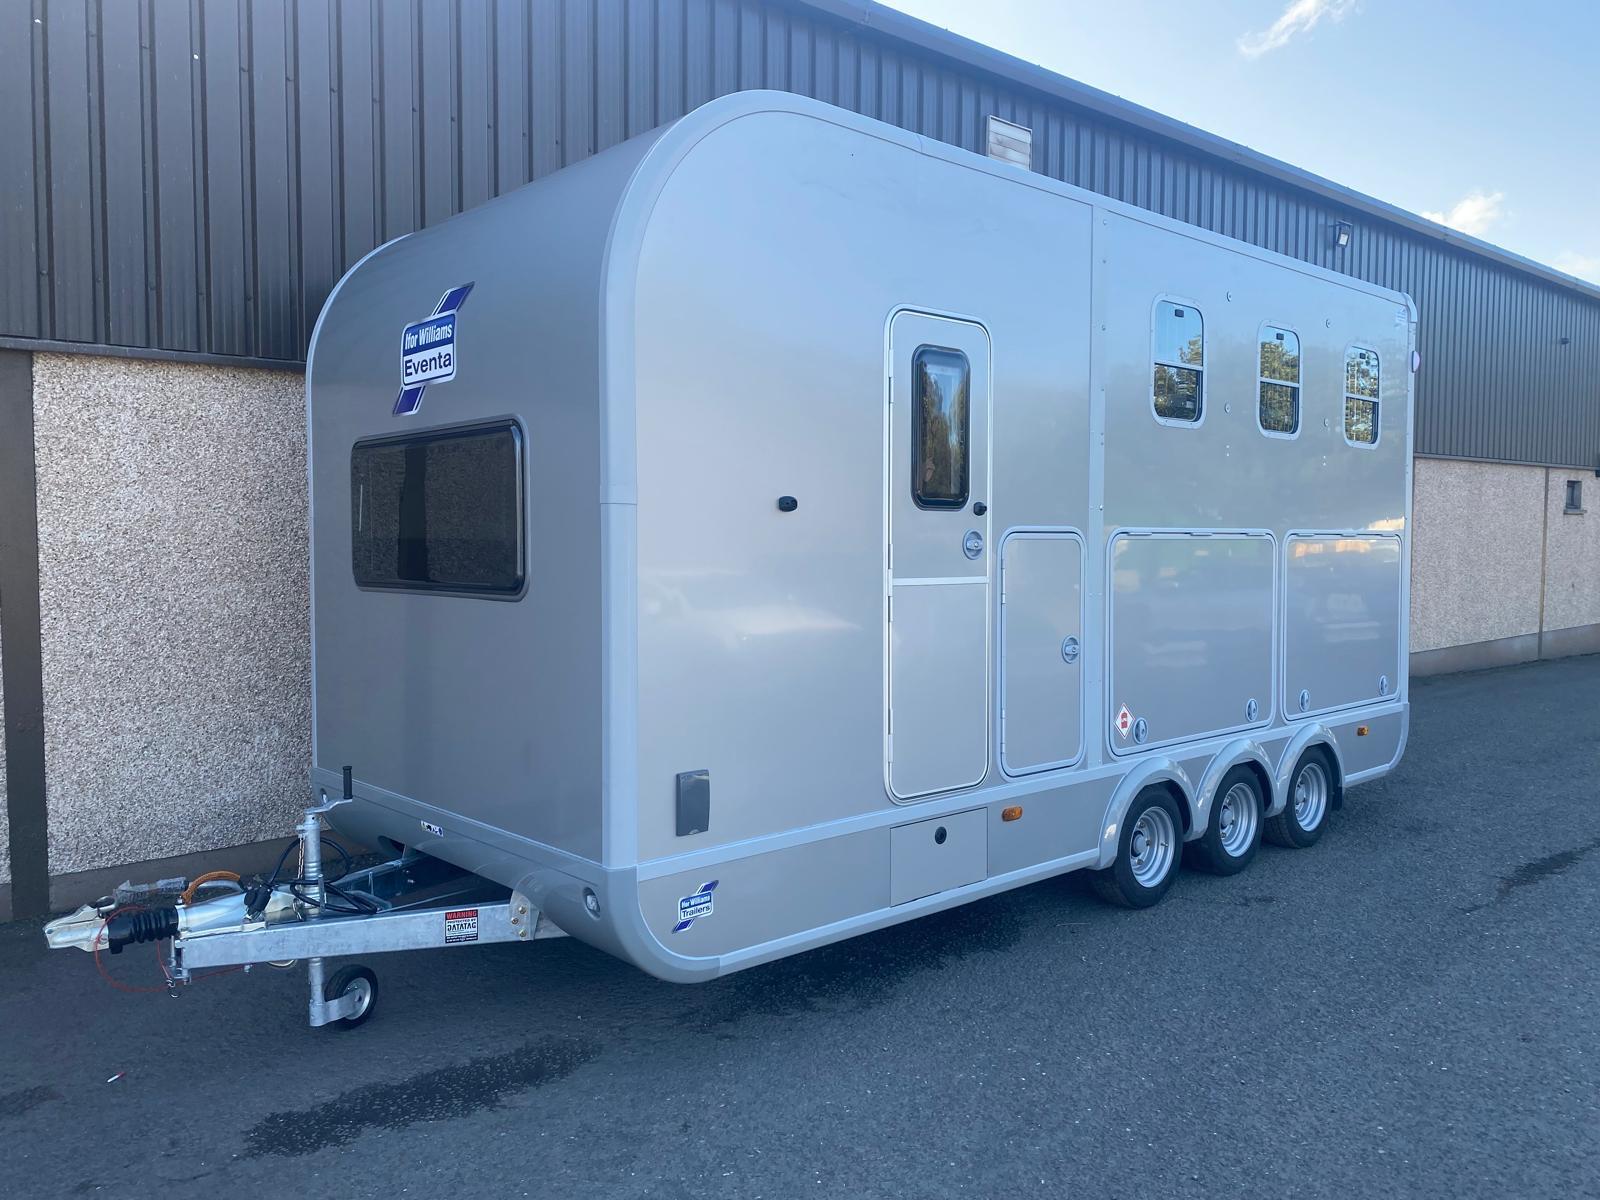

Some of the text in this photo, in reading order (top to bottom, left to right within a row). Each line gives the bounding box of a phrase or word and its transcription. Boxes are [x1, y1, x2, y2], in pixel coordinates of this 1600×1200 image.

[404, 324, 453, 350] Ifor Williams
[404, 352, 452, 377] Eventa
[446, 910, 477, 919] WARNING
[682, 905, 711, 918] Trailers
[447, 922, 477, 932] DATATAG
